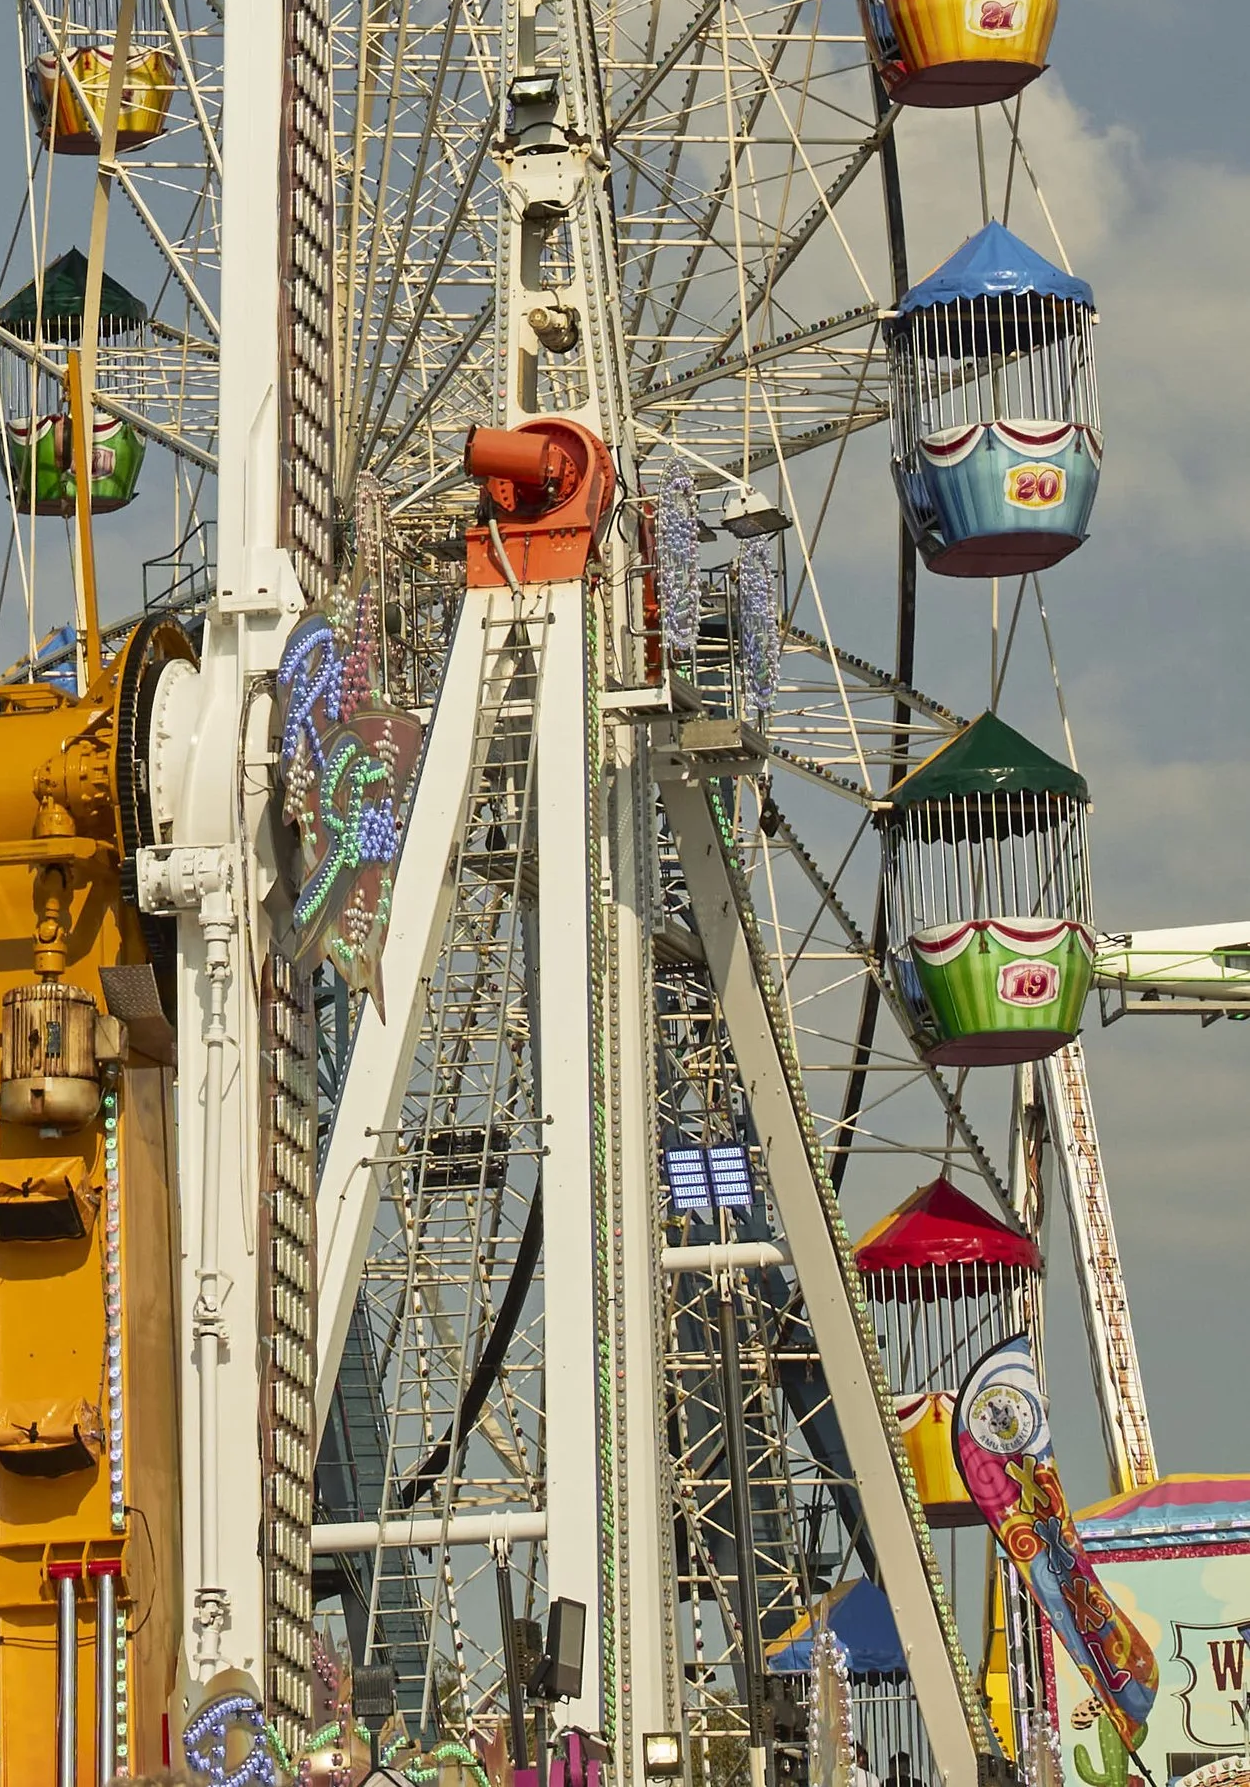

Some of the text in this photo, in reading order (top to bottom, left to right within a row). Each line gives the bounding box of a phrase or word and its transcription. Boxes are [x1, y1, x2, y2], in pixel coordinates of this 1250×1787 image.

[980, 0, 1018, 31] 21
[1015, 469, 1060, 502] 20
[1011, 969, 1049, 999] 19
[979, 1420, 1031, 1451] AMUSEMENTS
[1004, 1454, 1132, 1693] XXXL
